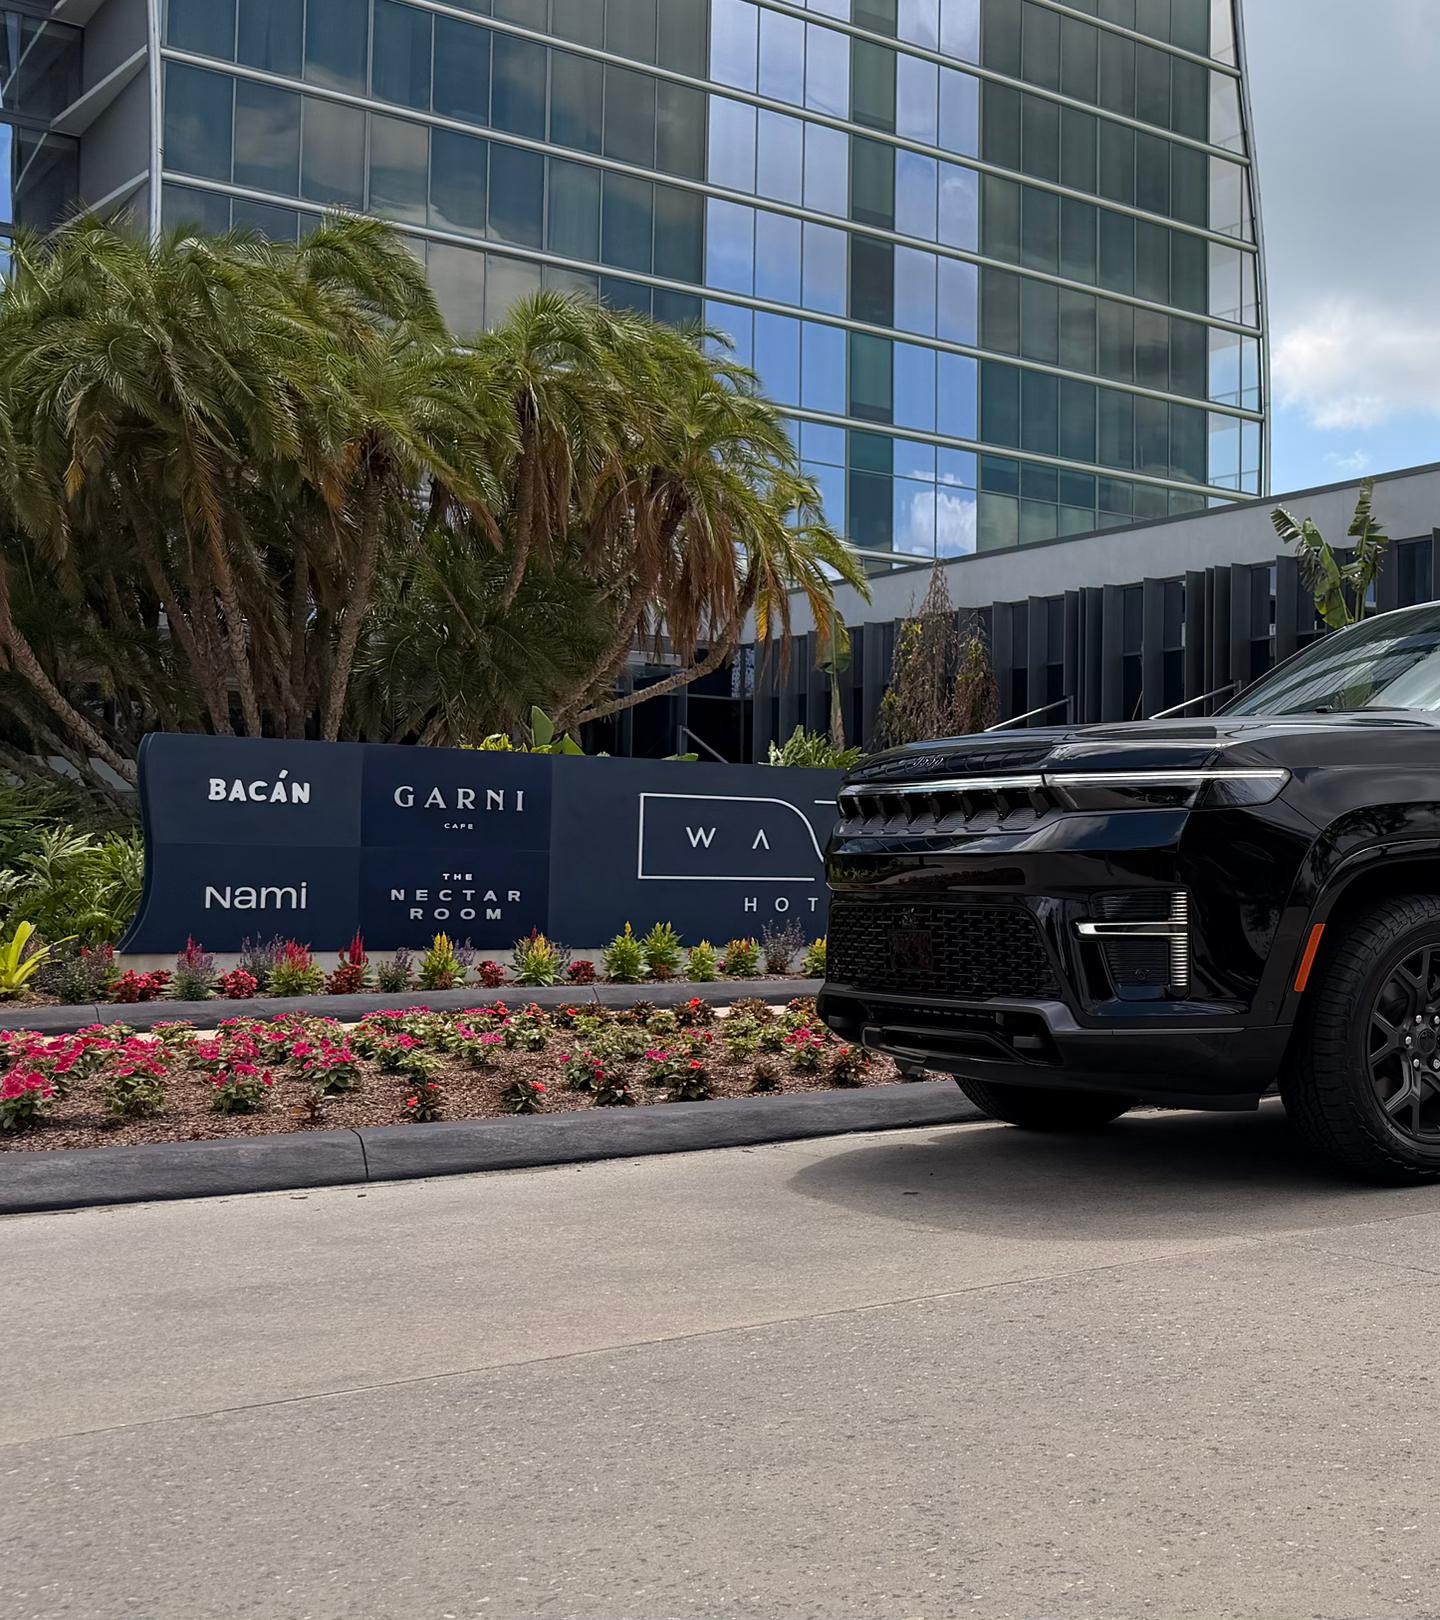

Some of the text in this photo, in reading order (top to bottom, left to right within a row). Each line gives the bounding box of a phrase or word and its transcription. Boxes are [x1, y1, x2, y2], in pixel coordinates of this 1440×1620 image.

[208, 769, 311, 804] BACÁN
[393, 785, 524, 812] GARNI
[443, 822, 474, 830] CAFE
[685, 826, 770, 850] WA
[442, 873, 473, 881] THE
[205, 881, 307, 910] Nami
[390, 889, 521, 902] NECTAR
[744, 897, 819, 912] HOT
[409, 908, 502, 920] ROOM
